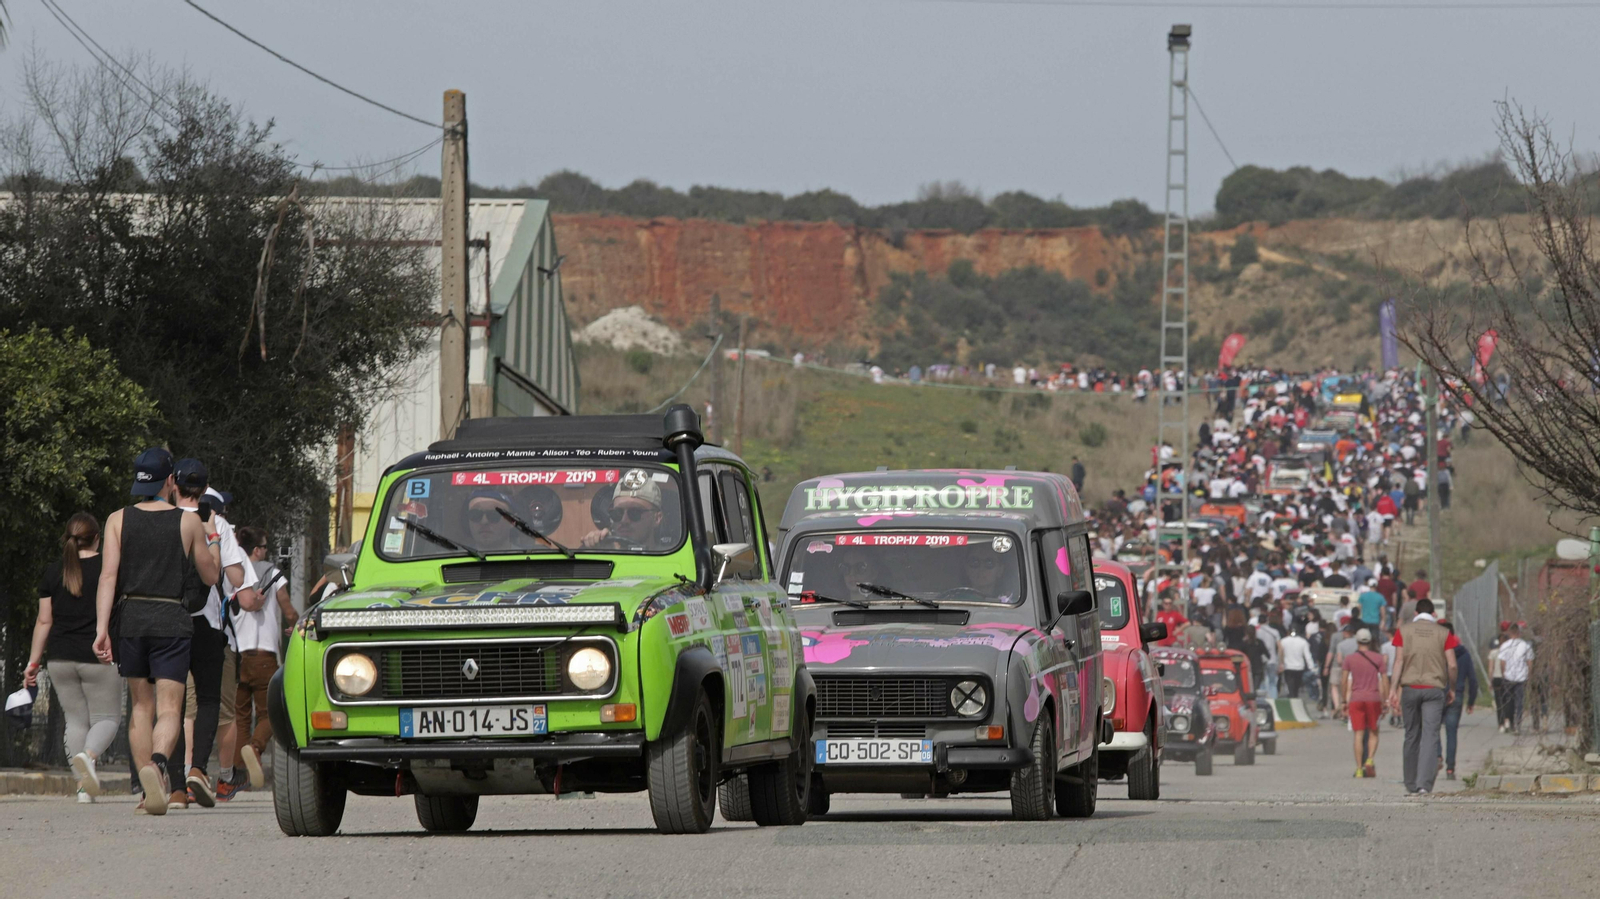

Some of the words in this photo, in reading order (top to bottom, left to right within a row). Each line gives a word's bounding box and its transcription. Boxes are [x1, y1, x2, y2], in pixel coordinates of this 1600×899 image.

[424, 452, 460, 461] Raphaël
[465, 451, 500, 459] Antoine
[541, 449, 569, 457] Alison
[632, 449, 659, 457] Youna
[473, 472, 491, 485] 4L
[500, 471, 558, 485] TROPHY
[565, 470, 597, 483] 2019
[410, 481, 426, 496] B
[803, 485, 1034, 511] HYGIPROPRE
[851, 535, 867, 545] 4L
[873, 535, 919, 545] TROPHY
[925, 535, 950, 545] 2019
[404, 725, 410, 734] F
[418, 708, 530, 734] AN-014-JS
[533, 719, 546, 732] 27
